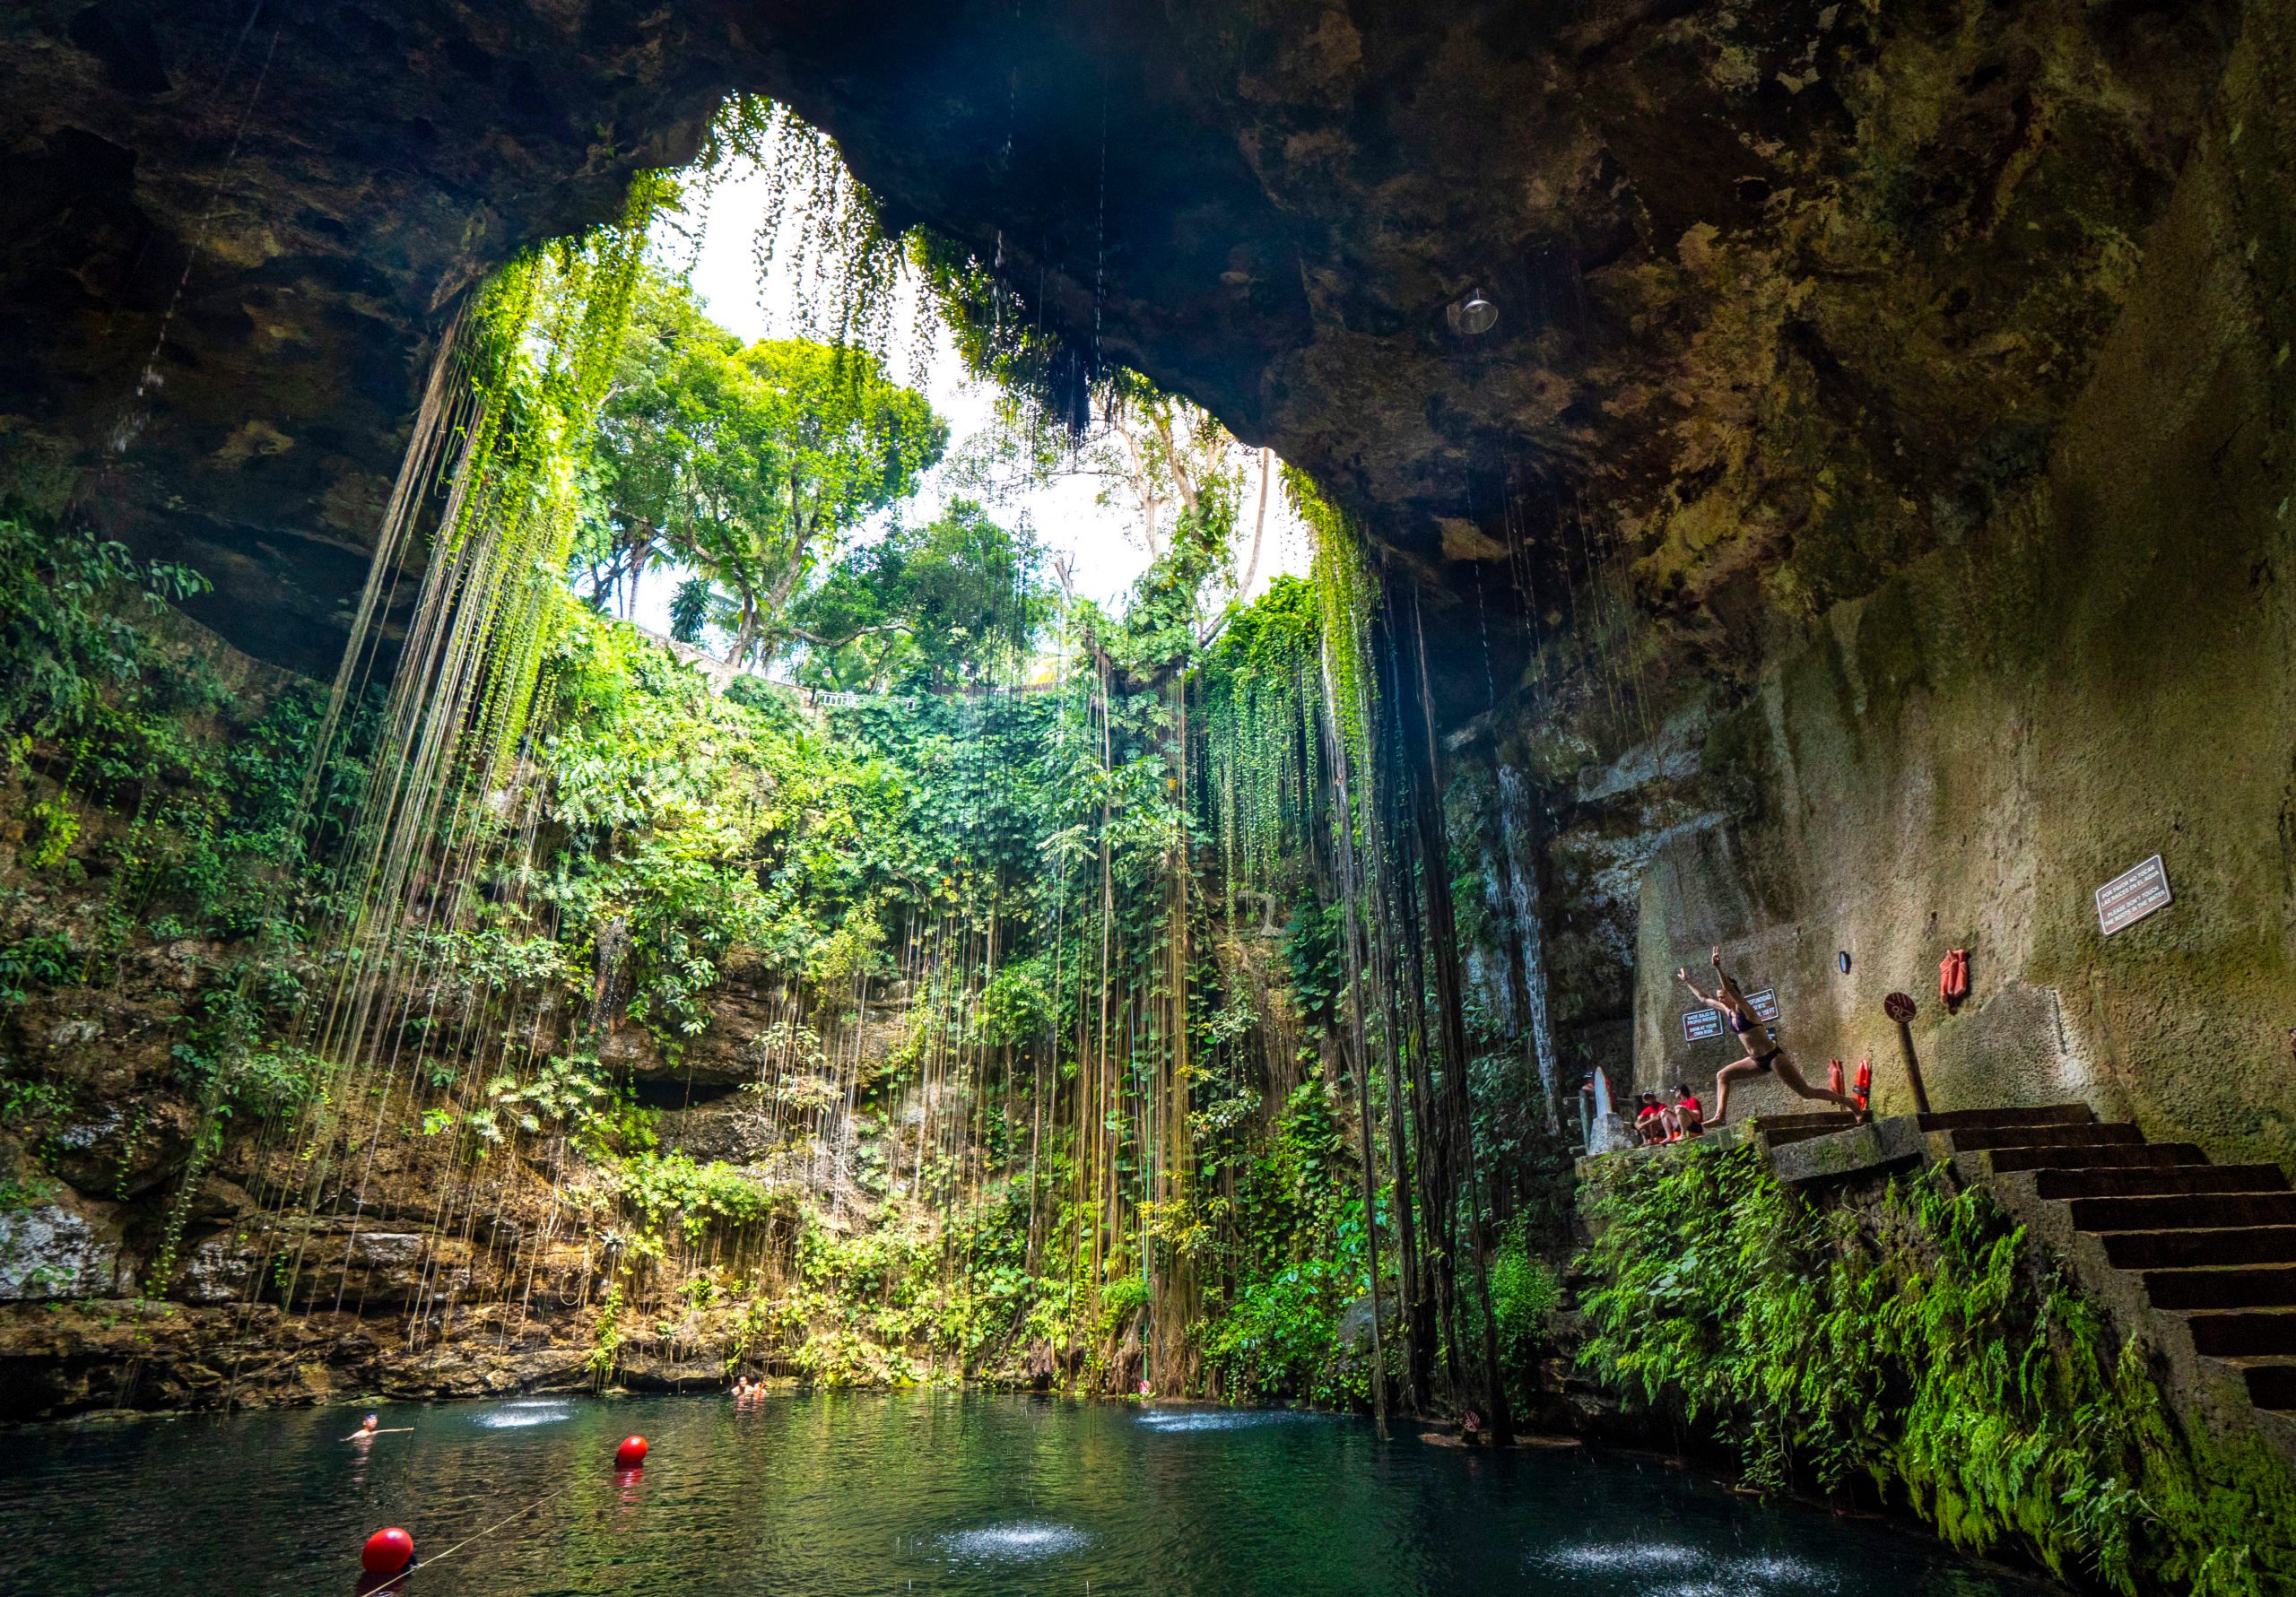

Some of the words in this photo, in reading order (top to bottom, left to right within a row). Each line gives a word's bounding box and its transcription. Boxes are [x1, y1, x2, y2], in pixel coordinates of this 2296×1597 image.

[2101, 890, 2113, 898] POR
[2113, 881, 2129, 892] FAVOR
[2129, 875, 2137, 883] NO
[2137, 864, 2155, 878] TOCAR
[2101, 898, 2111, 907] LAS
[2144, 870, 2160, 881] AGUA
[2104, 918, 2114, 927] THE
[2114, 908, 2132, 921] ROOTS
[2137, 899, 2148, 908] THE
[2147, 890, 2166, 903] WATER
[2108, 905, 2126, 918] PLEASE
[2126, 896, 2141, 907] DON'T
[2141, 885, 2160, 898] TOUCH
